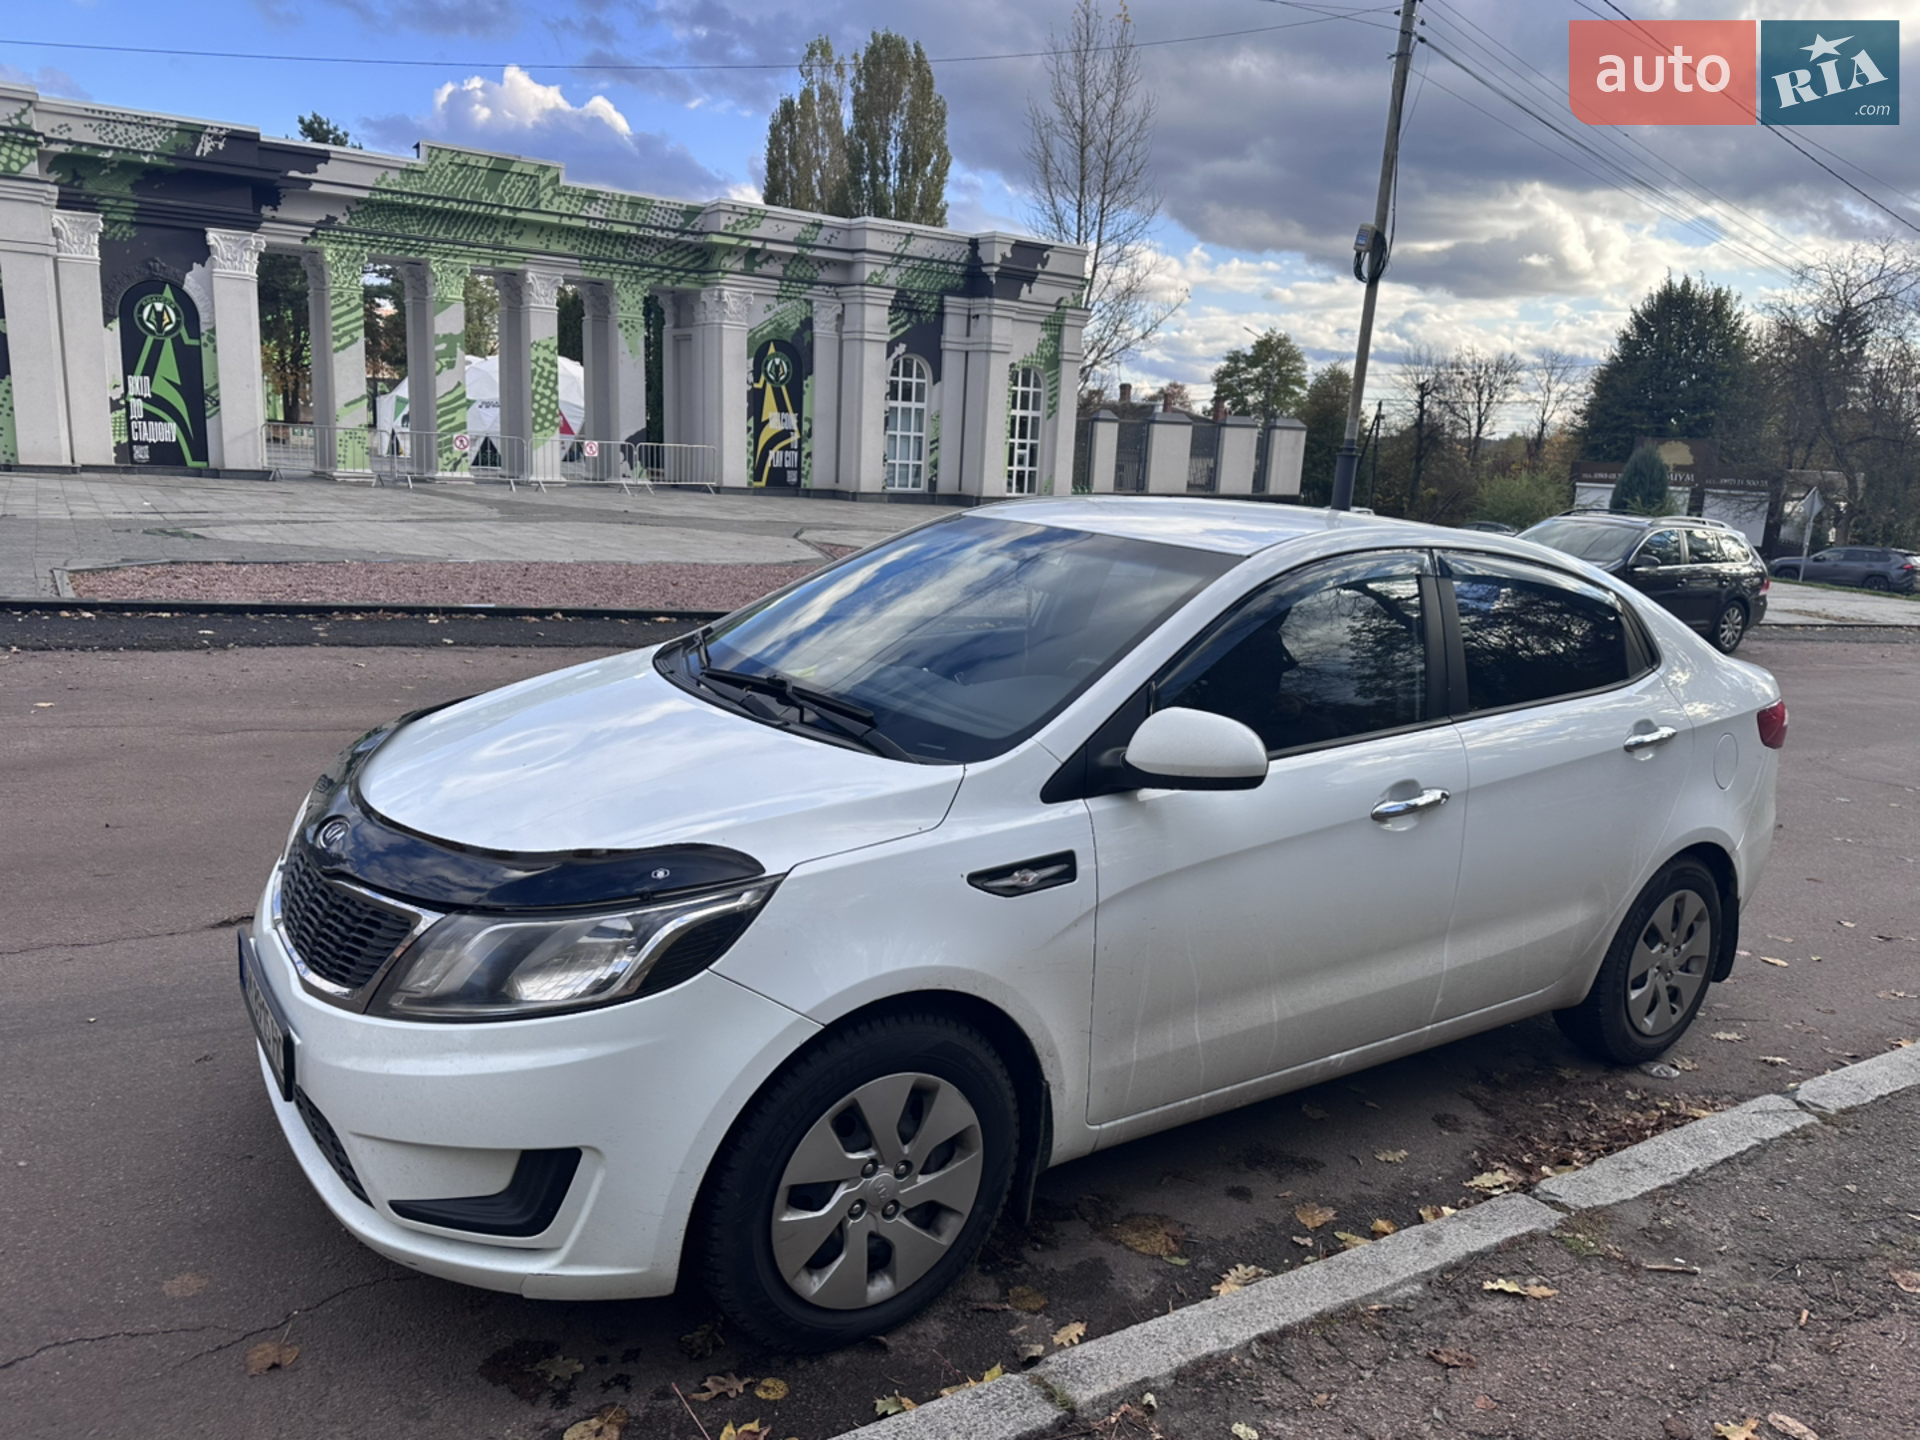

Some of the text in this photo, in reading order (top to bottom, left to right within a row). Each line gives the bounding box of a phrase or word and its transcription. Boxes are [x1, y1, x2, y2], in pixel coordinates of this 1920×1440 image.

[127, 375, 152, 398] ВХІД
[130, 398, 144, 420] ДО
[768, 411, 798, 430] WELCOME
[131, 421, 177, 443] СТАДІОНУ
[789, 431, 798, 449] TO
[768, 450, 798, 468] PLAY CITY
